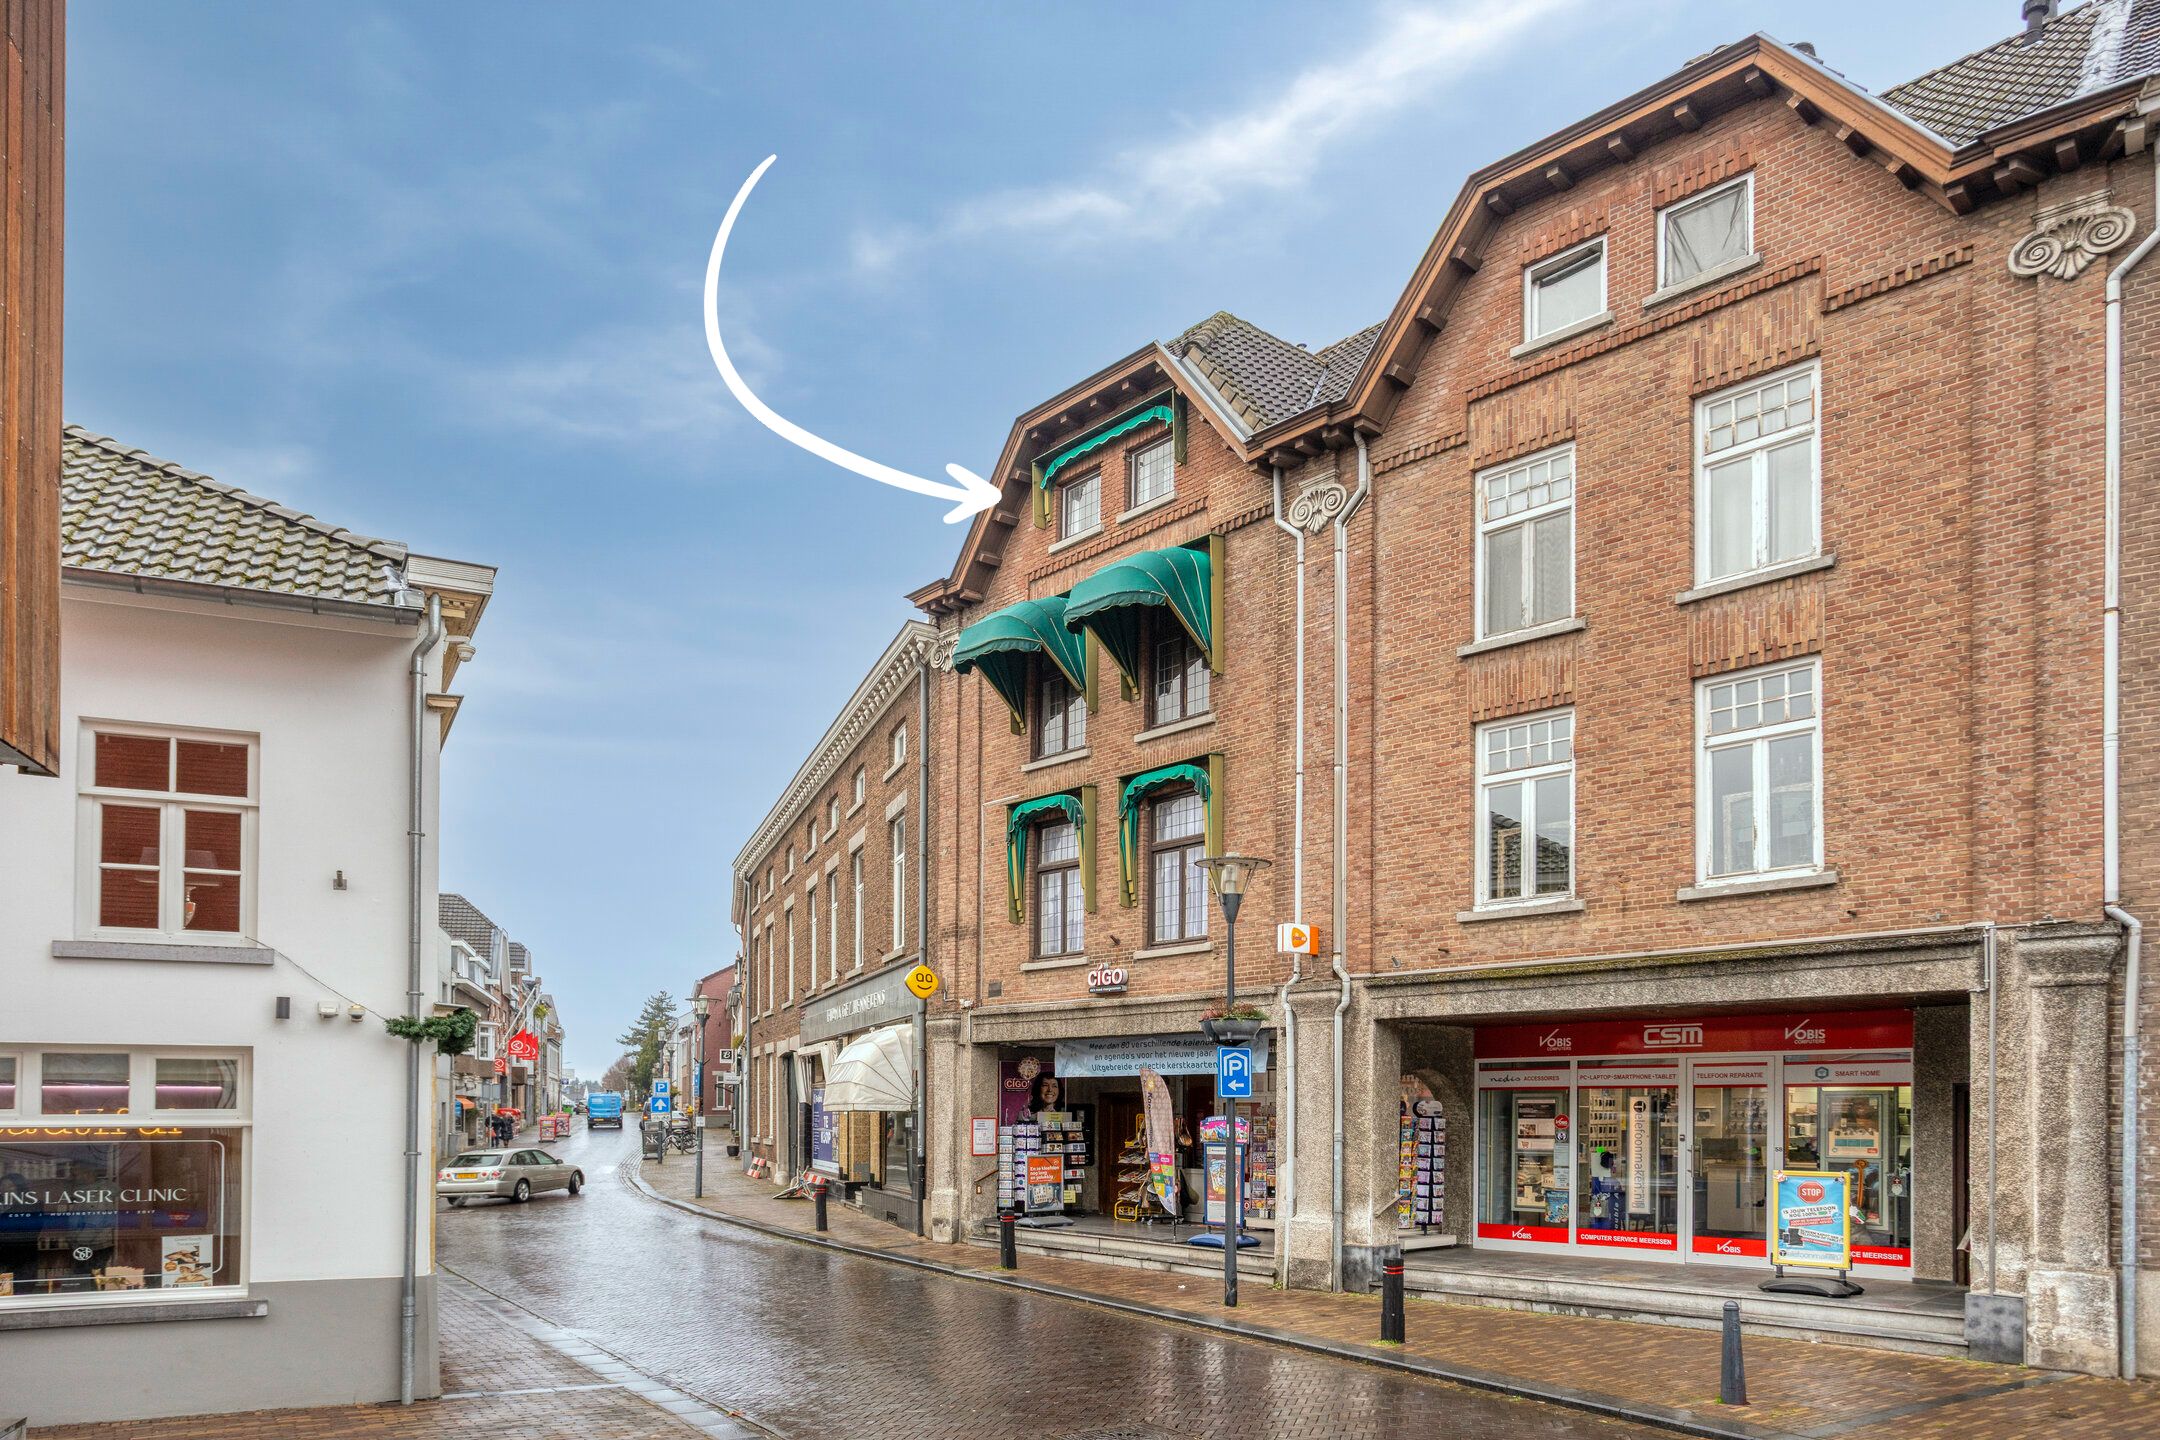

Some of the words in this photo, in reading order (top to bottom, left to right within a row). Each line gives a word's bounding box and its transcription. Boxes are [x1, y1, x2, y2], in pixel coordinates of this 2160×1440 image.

[1539, 1028, 1572, 1047] VOBIS
[1784, 1019, 1826, 1040] VOBIS
[1131, 1039, 1181, 1049] verschillende
[1136, 1052, 1154, 1060] voor
[1154, 1050, 1167, 1059] het
[1168, 1050, 1195, 1058] nieuwe
[1092, 1062, 1133, 1072] Uitgebreide
[0, 1190, 38, 1206] INS
[45, 1189, 113, 1205] LASER
[120, 1188, 188, 1203] CLINIC
[1801, 1188, 1821, 1196] STOP
[1806, 1205, 1836, 1213] TELEFOON
[1512, 1227, 1532, 1239] VOBIS
[1580, 1233, 1613, 1242] COMPUTER
[1613, 1235, 1639, 1243] SERVICE
[1639, 1237, 1672, 1246] MEERSSEN
[1716, 1240, 1742, 1253] VOBIS
[1862, 1251, 1904, 1261] MEERSSEN
